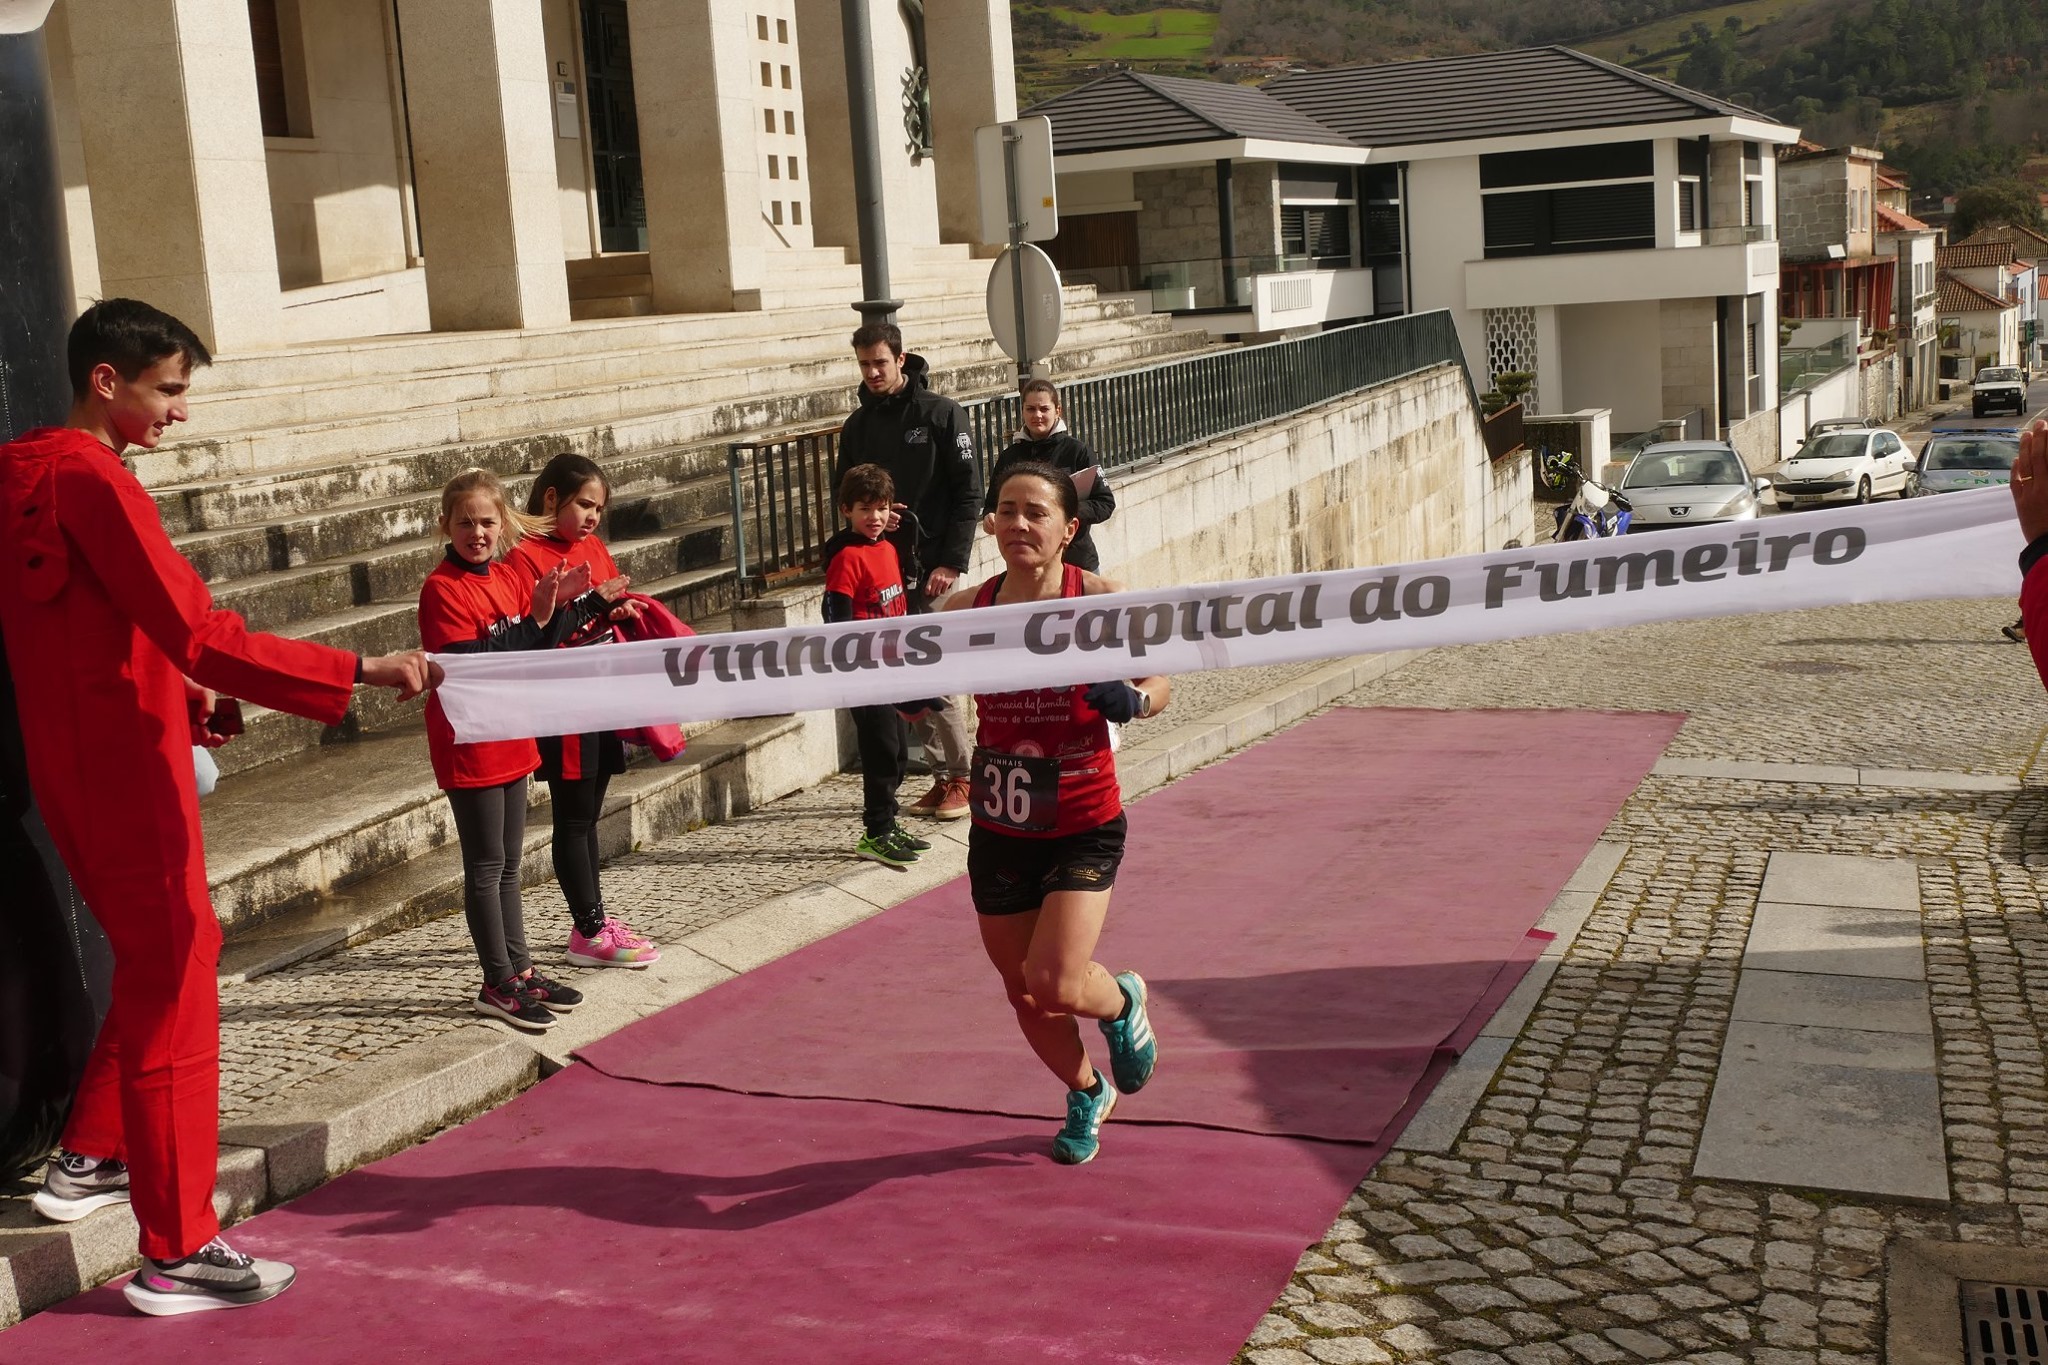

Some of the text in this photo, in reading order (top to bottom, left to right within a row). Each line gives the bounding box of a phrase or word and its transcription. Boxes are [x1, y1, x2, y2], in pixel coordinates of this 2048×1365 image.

[880, 583, 900, 602] TRAIL
[1024, 584, 1322, 657] Capital
[1349, 575, 1451, 625] do
[1483, 526, 1867, 609] Fumeiro
[988, 757, 1023, 767] VINHAIS
[983, 763, 1032, 823] 36
